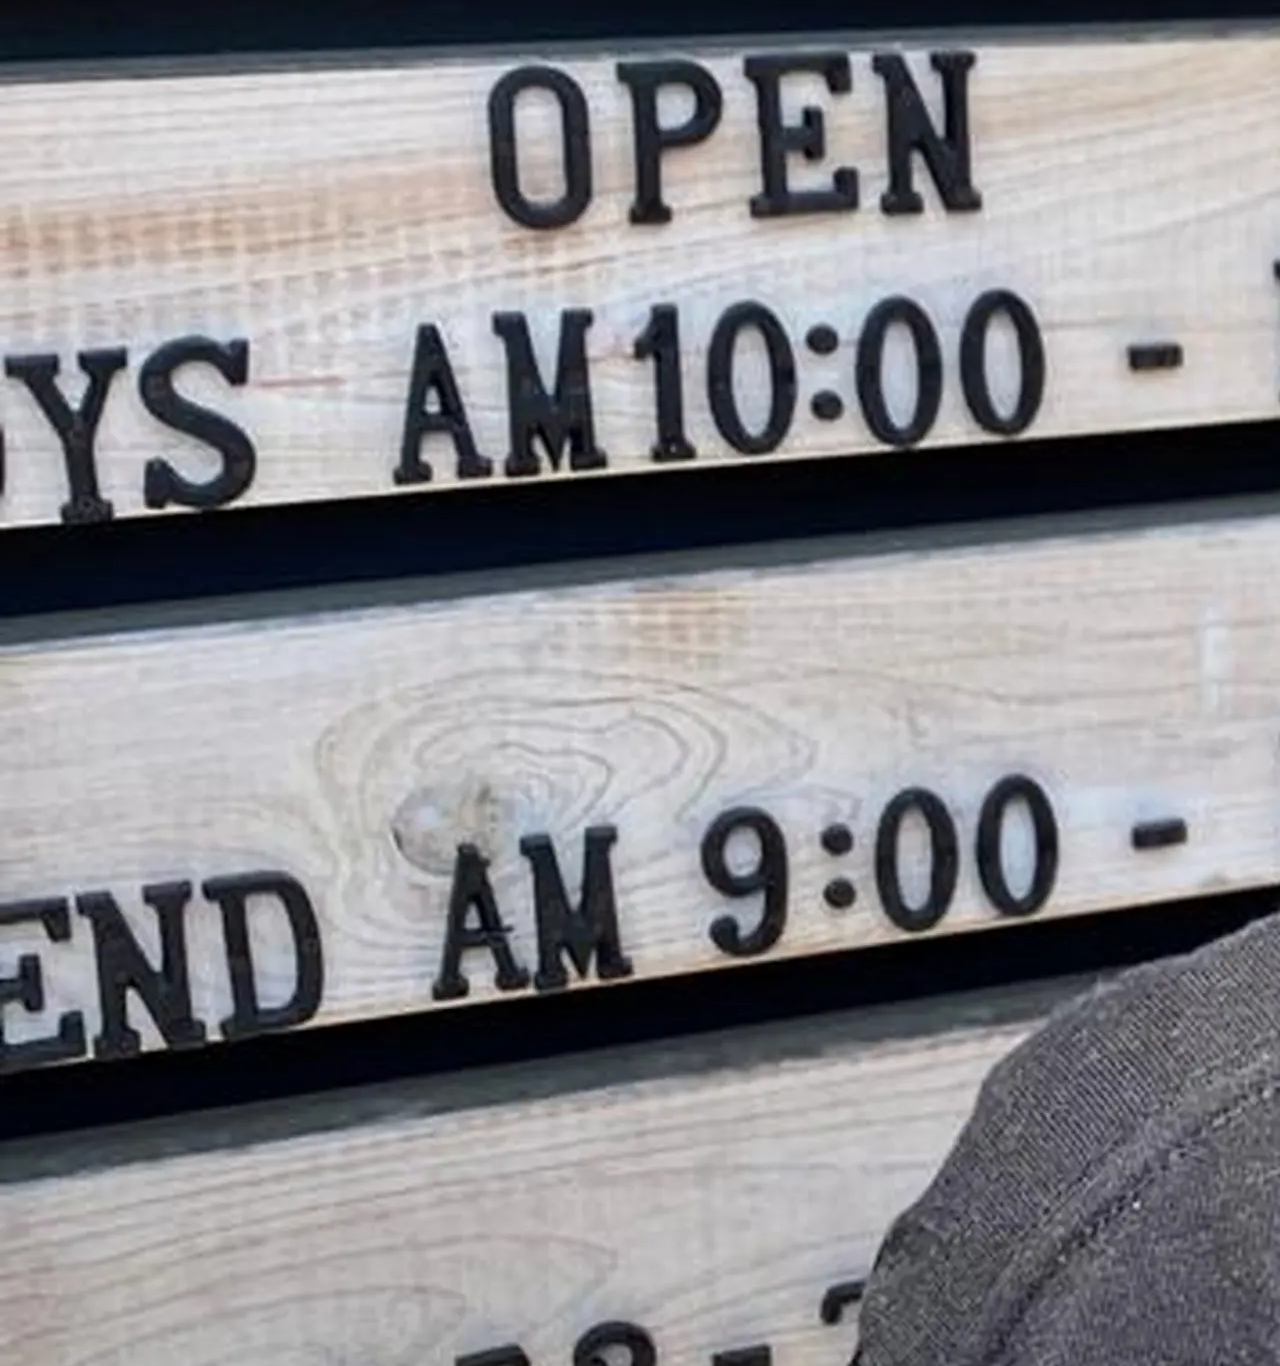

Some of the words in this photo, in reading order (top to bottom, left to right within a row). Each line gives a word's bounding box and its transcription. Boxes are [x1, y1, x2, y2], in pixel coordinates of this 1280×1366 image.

[486, 50, 982, 229] OPEN
[0, 335, 256, 524] YS
[1128, 342, 1183, 370] -
[432, 826, 633, 999] AM
[700, 773, 1059, 957] 9:00
[1132, 817, 1188, 850] -
